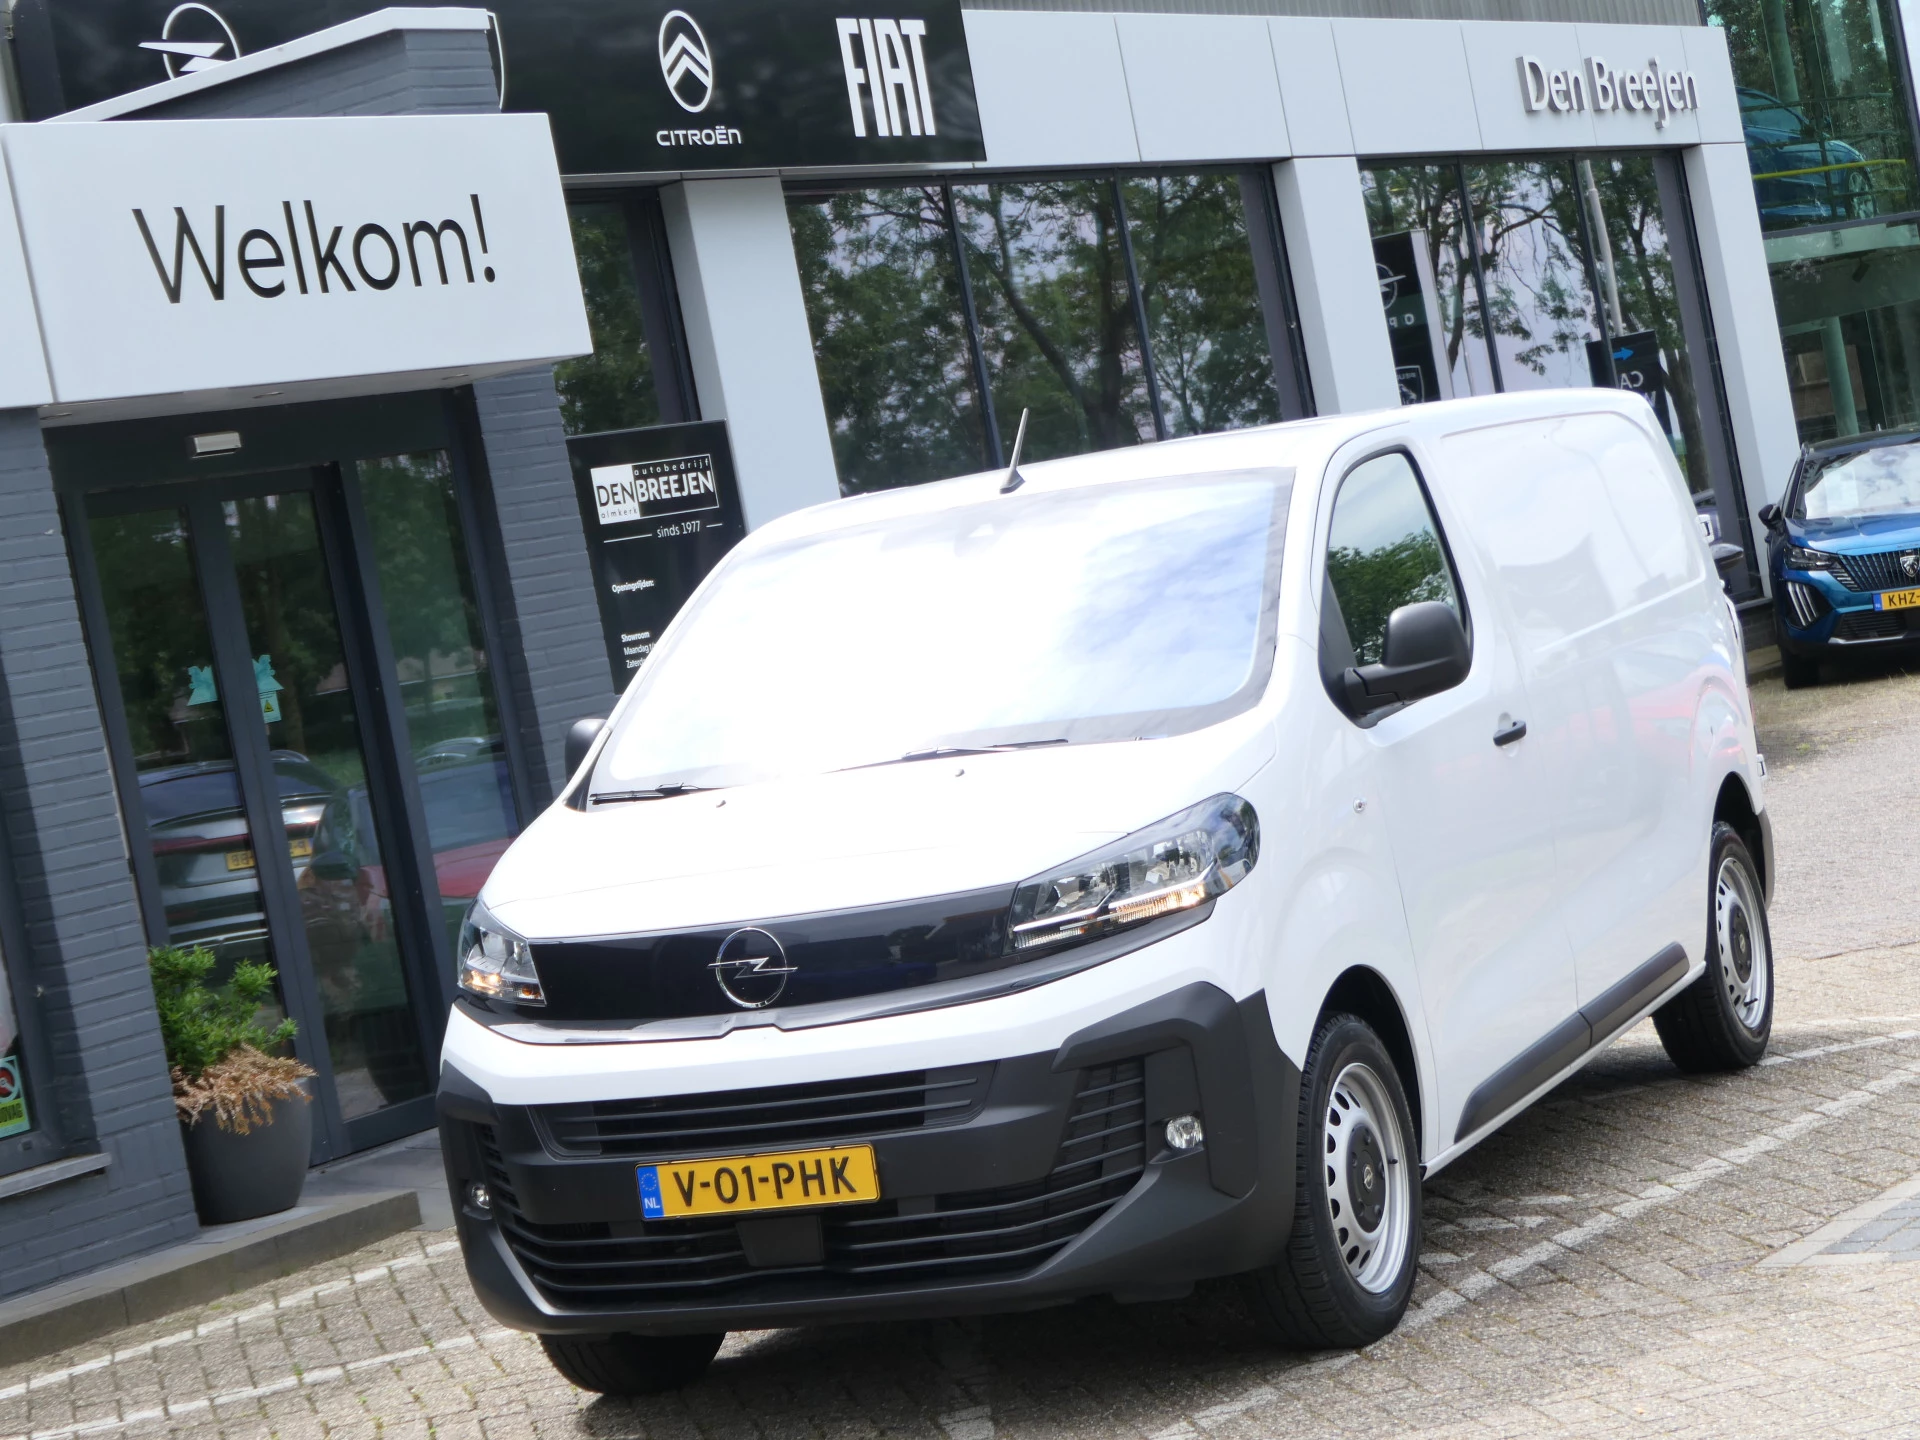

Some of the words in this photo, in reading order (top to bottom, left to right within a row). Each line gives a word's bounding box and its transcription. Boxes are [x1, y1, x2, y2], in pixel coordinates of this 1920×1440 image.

[834, 17, 937, 138] FIAT
[1515, 55, 1589, 113] Den
[1584, 55, 1701, 129] Breejen
[131, 193, 497, 304] Welkom!
[634, 458, 709, 476] autobedrijf
[596, 481, 636, 508] DEN
[636, 470, 714, 503] BREEJEN
[601, 507, 638, 519] almkerk
[657, 524, 680, 538] sinds
[682, 520, 701, 535] 1977
[621, 631, 650, 643] Showroom
[624, 644, 649, 656] Maandag
[672, 1155, 857, 1208] V-01-PHK
[644, 1197, 661, 1209] NL
